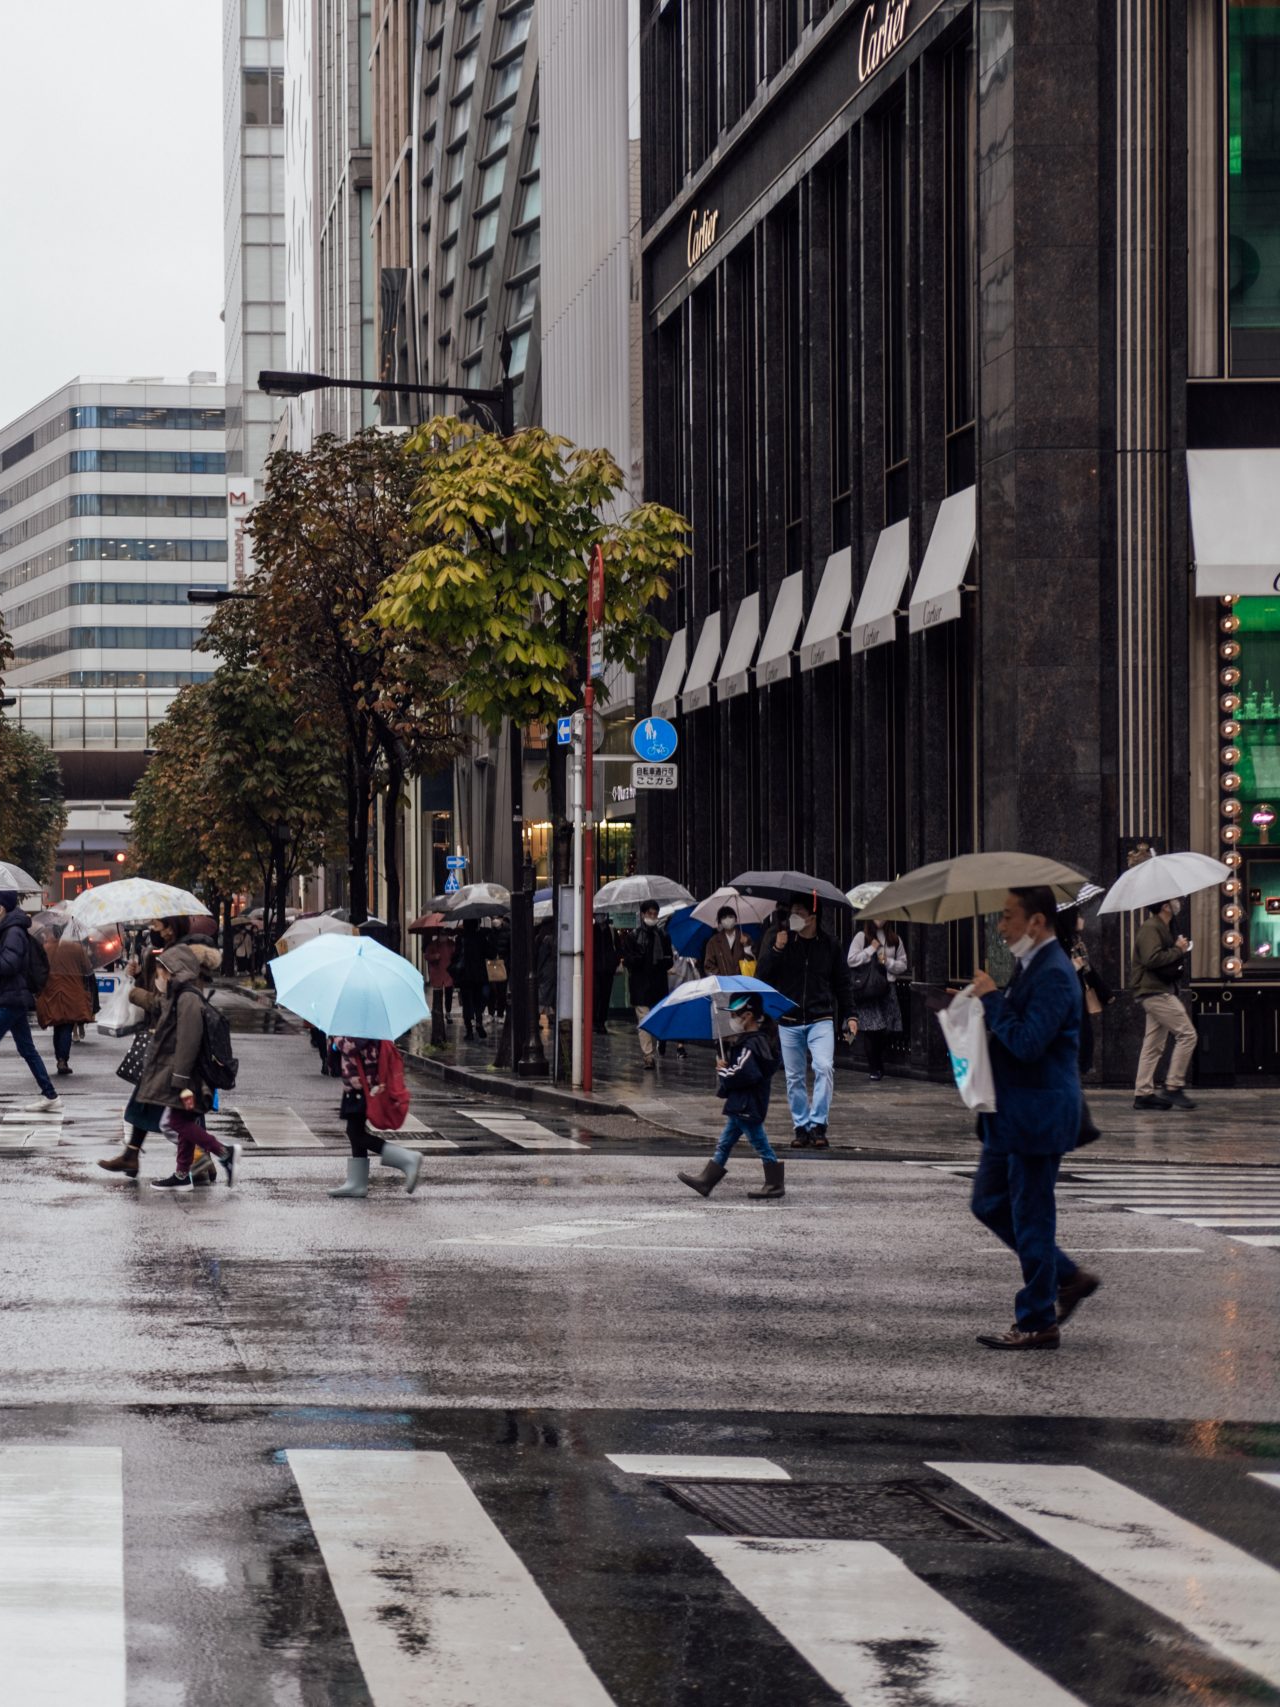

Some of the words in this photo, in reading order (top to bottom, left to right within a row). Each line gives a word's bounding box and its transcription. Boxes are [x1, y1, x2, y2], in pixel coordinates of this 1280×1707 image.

[859, 0, 910, 82] Cartier
[688, 208, 719, 268] Cartier
[637, 777, 674, 786] ここから
